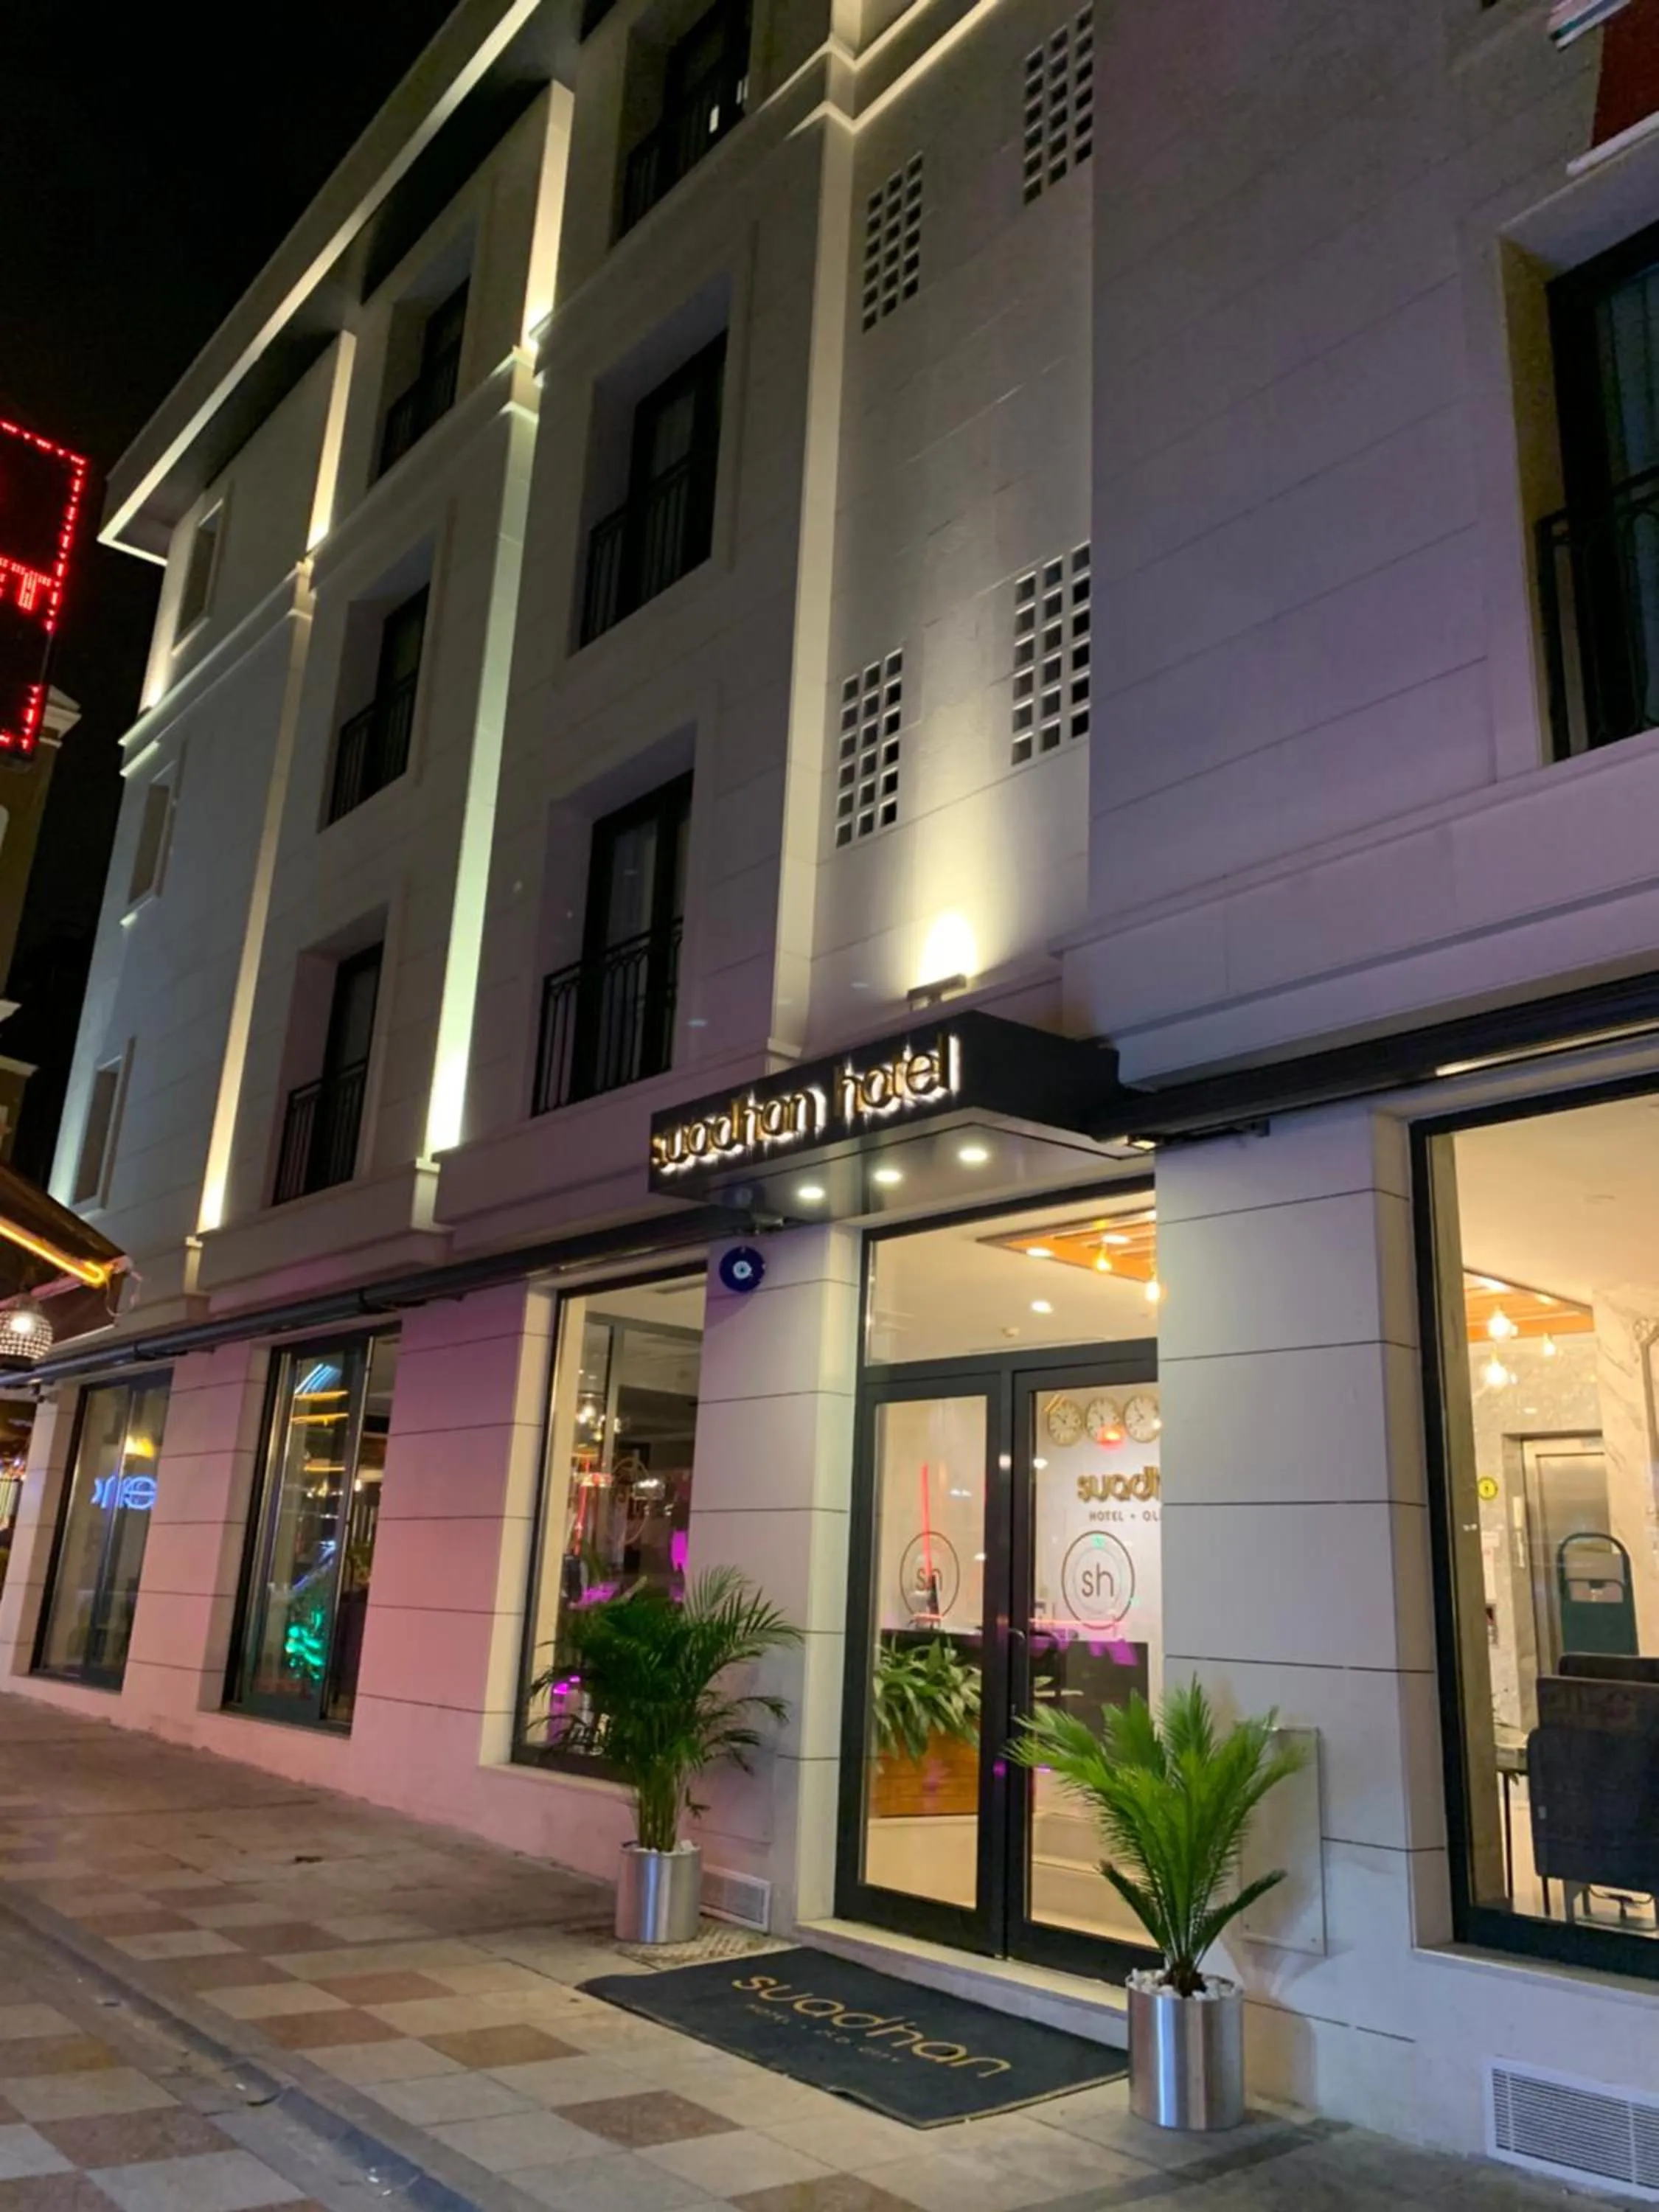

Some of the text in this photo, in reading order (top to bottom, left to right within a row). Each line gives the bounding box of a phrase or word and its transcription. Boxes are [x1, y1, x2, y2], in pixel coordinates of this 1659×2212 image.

[652, 1032, 961, 1174] suadhan hotel
[1089, 1509, 1124, 1522] HOTEL
[1081, 1562, 1114, 1597] sh
[731, 1975, 1012, 2078] suadhan
